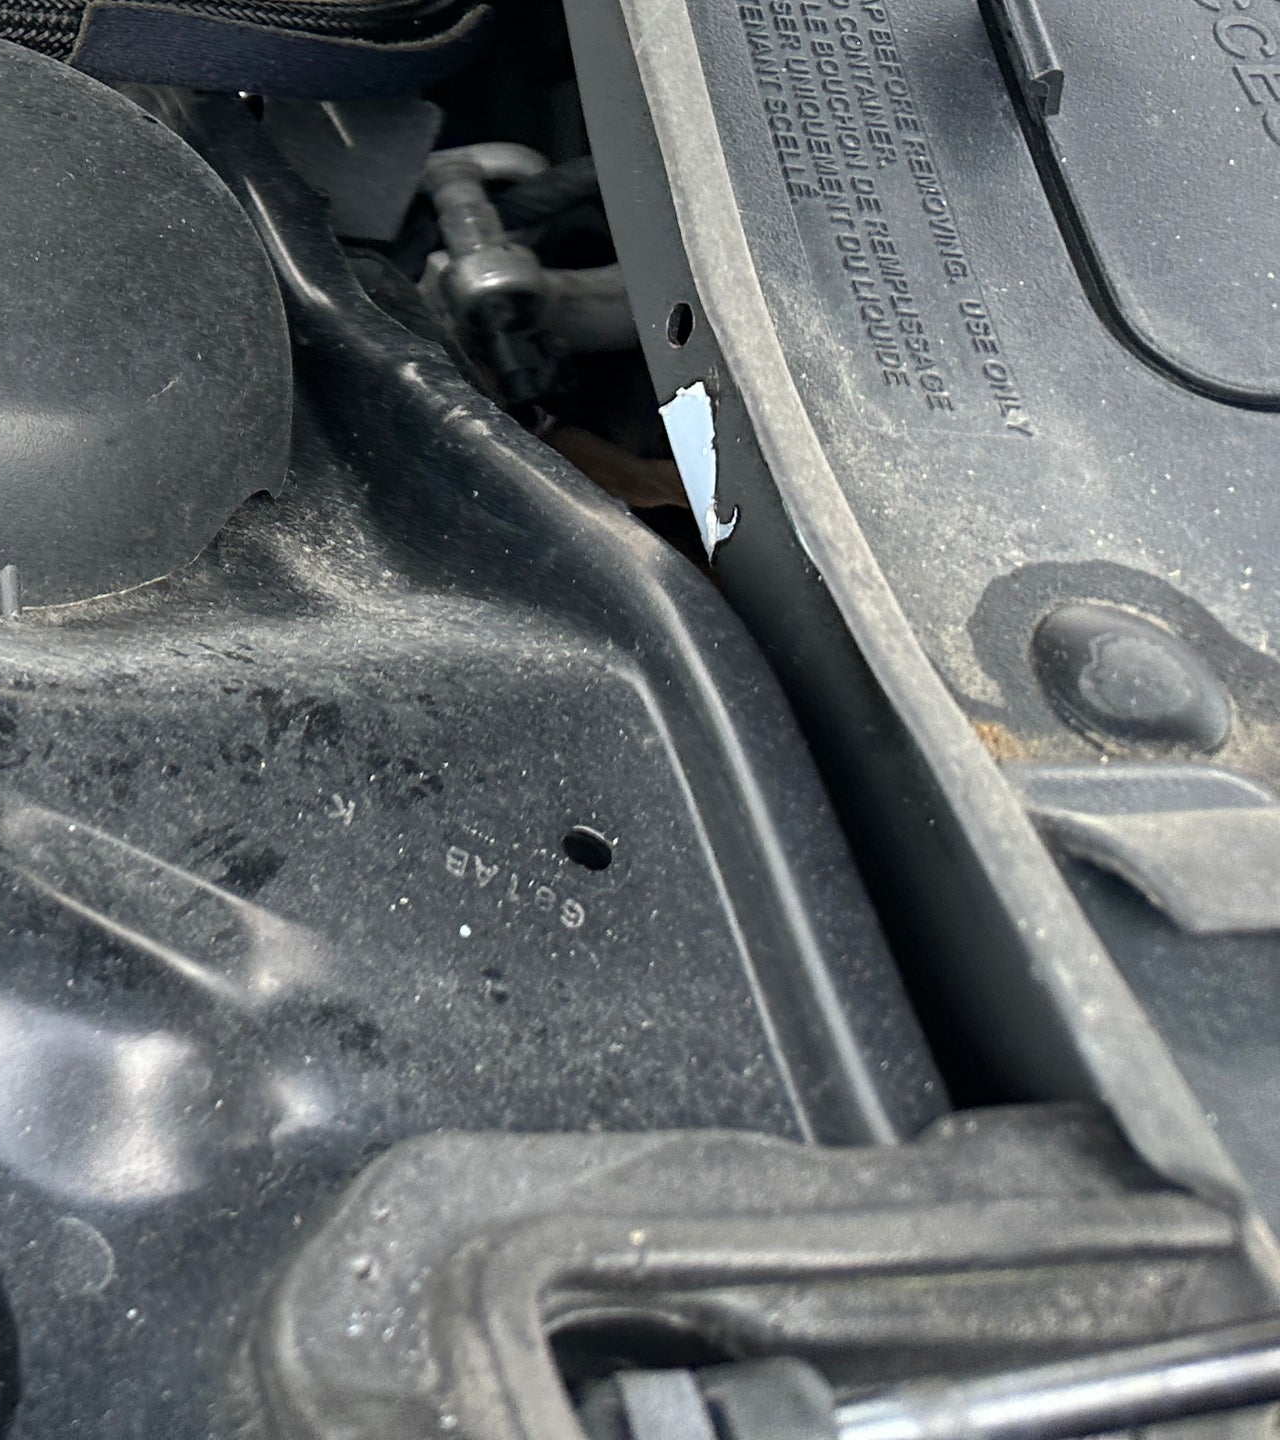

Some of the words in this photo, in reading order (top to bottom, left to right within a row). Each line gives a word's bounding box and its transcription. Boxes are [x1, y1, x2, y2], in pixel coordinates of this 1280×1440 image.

[800, 1, 829, 35] LE
[785, 56, 855, 230] UNIQUEMENT
[810, 39, 870, 170] BOUCHON
[836, 233, 870, 273] DU
[850, 175, 883, 214] DE
[868, 28, 921, 131] BEFORE
[959, 300, 999, 356] USE
[981, 359, 1035, 438] ONLY
[851, 278, 911, 388] LIQUIDE
[864, 218, 954, 412] REMPLISSAGE
